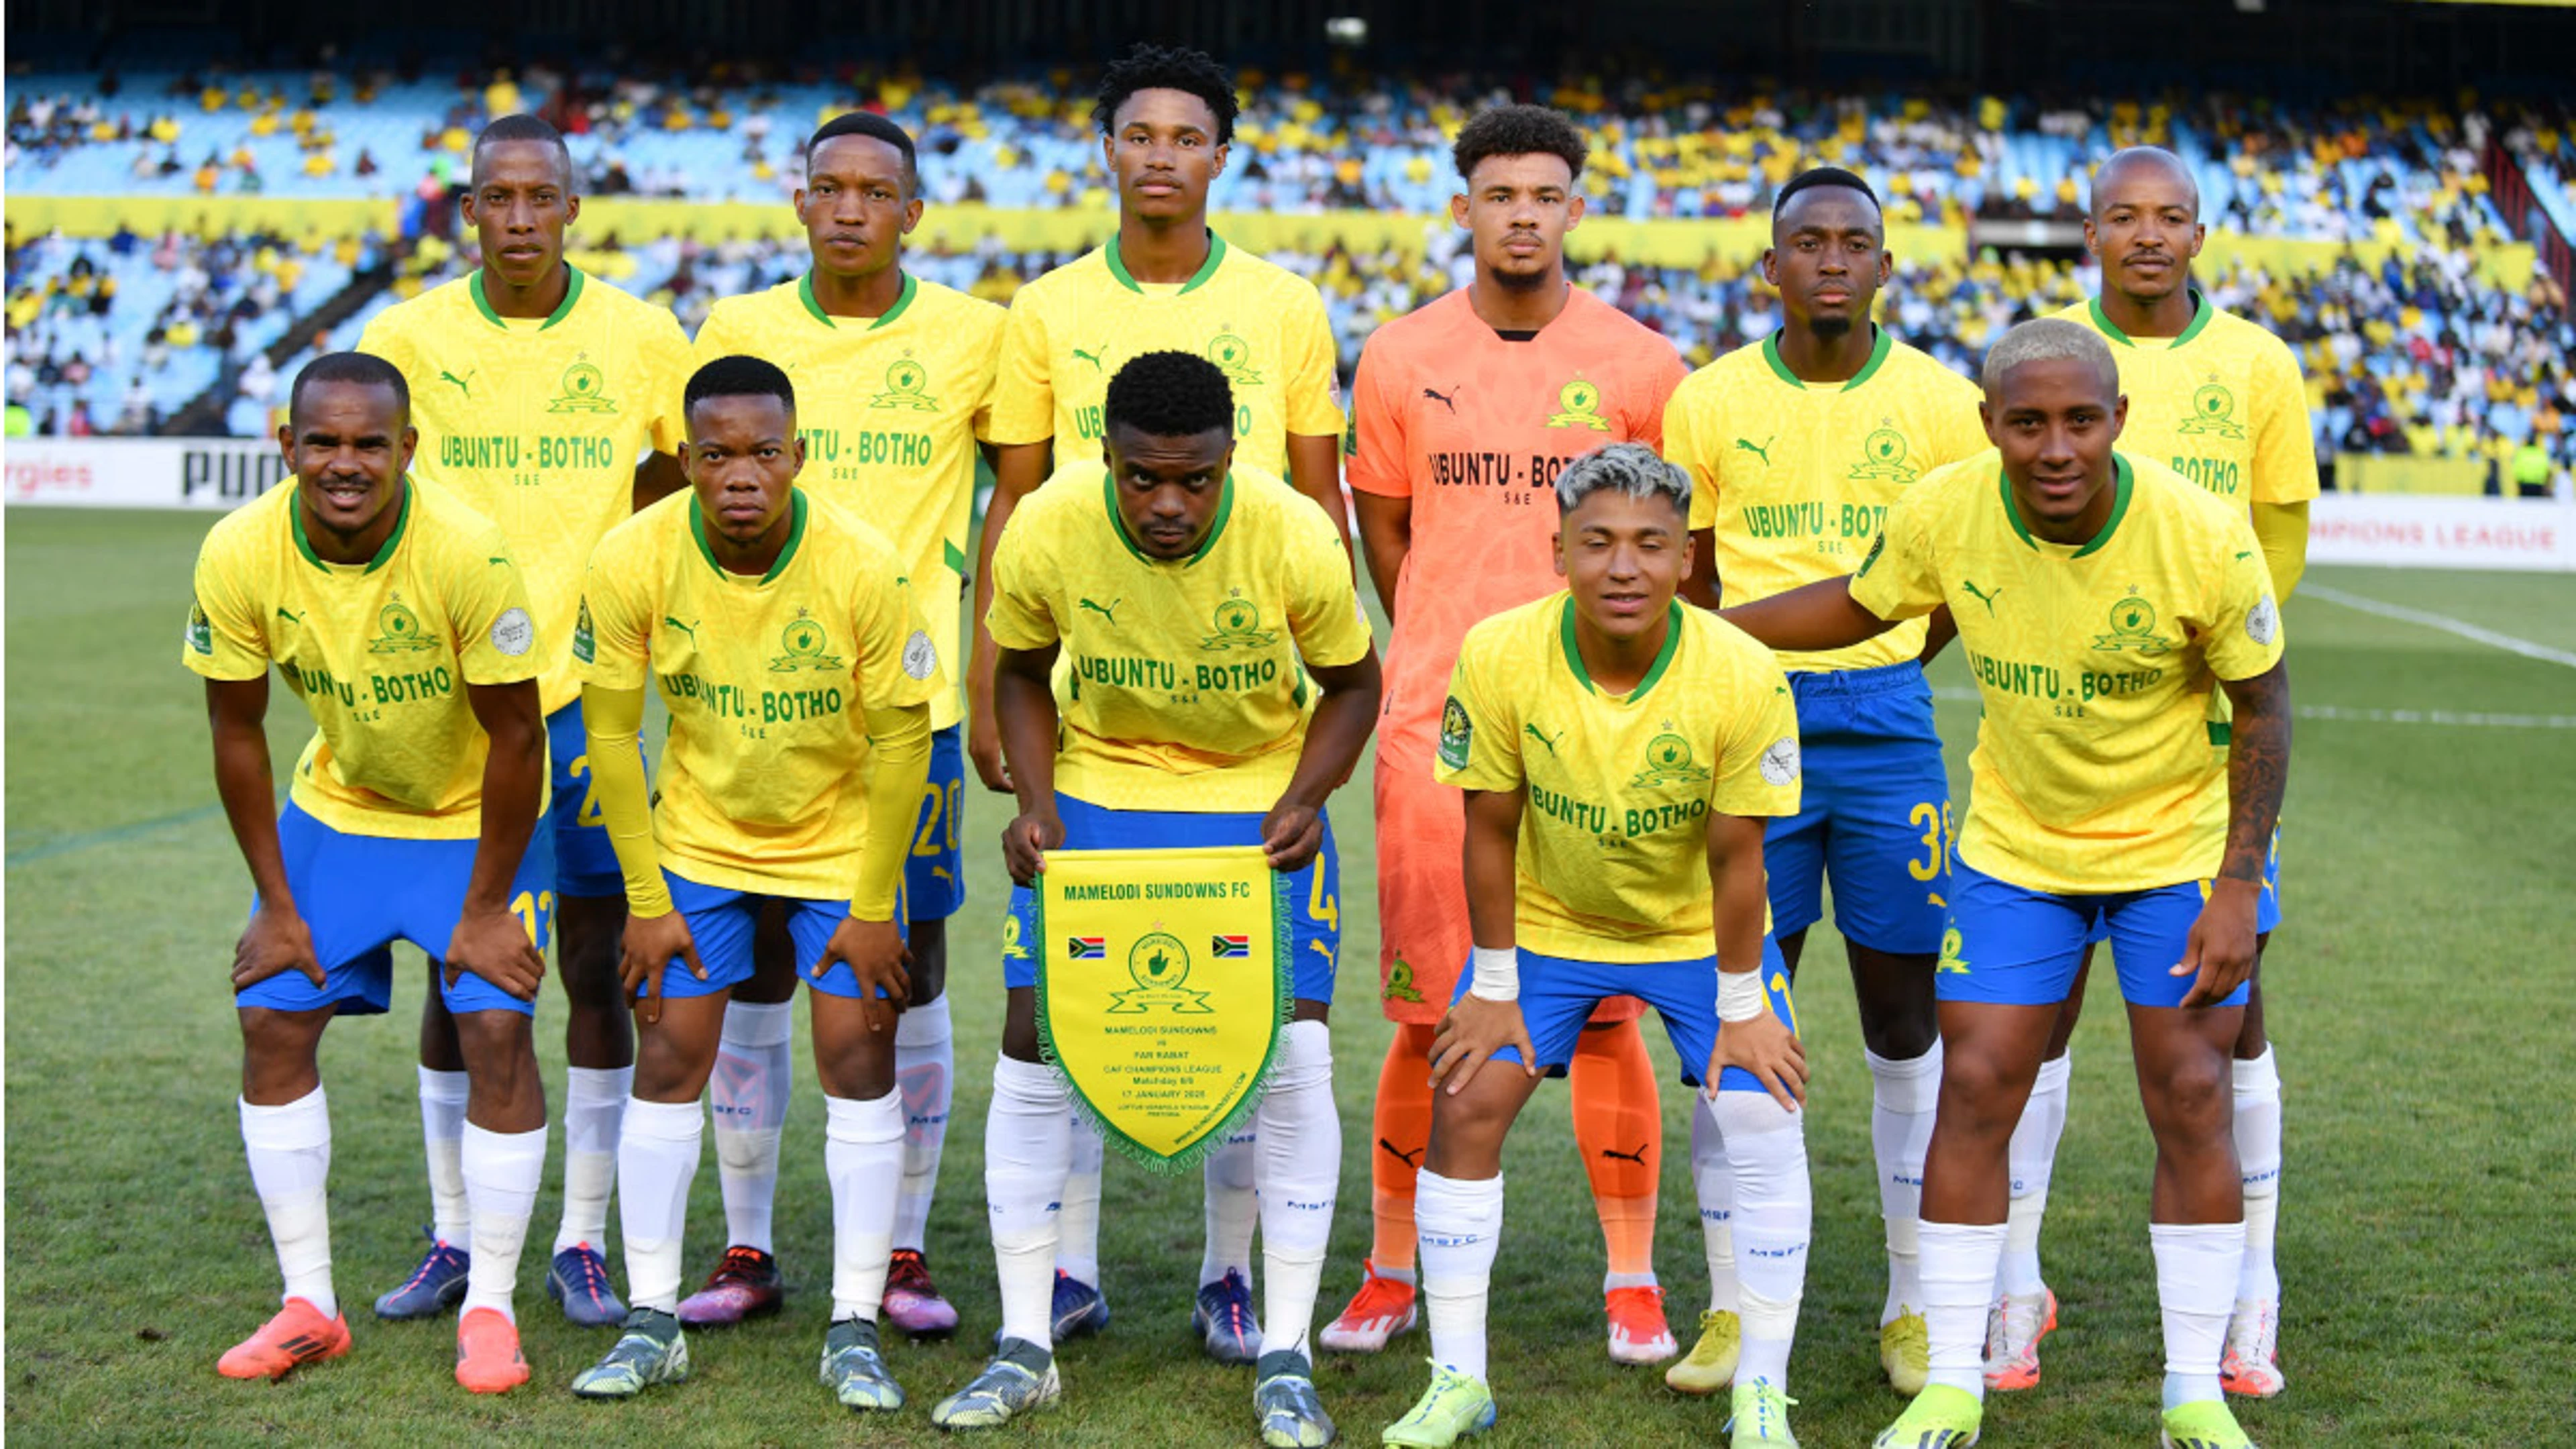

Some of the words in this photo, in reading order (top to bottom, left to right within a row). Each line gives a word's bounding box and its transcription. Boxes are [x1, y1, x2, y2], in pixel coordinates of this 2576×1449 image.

[441, 436, 519, 468] UBUNTU
[539, 436, 612, 468] BOTHO
[859, 431, 932, 466] BOTHO
[1429, 452, 1510, 486] UBUNTU
[1743, 502, 1823, 538] UBUNTU
[2436, 523, 2556, 551] LEAGUE
[371, 666, 451, 704] BOTHO
[1079, 654, 1175, 690] UBUNTU
[1197, 659, 1276, 692] BOTHO
[1970, 650, 2059, 700] UBUNTU
[2082, 667, 2162, 702] BOTHO
[761, 688, 842, 723] BOTHO
[912, 777, 961, 857] 20
[1532, 784, 1606, 835] BUNTU
[1626, 798, 1706, 839] BOTHO
[1064, 883, 1140, 900] MAMELODI
[1145, 881, 1227, 900] SUNDOWNS
[1231, 881, 1250, 898] FC
[1307, 851, 1338, 932] 4
[1104, 1026, 1157, 1034] MAMELODI
[1160, 1026, 1217, 1035] SUNDOWNS
[1104, 1065, 1122, 1073] CAF
[1124, 1065, 1181, 1073] CHAMPIONS
[1183, 1065, 1222, 1074] LEAGUE
[1132, 1077, 1177, 1086] Matchday
[1136, 1090, 1181, 1098] JANUARY
